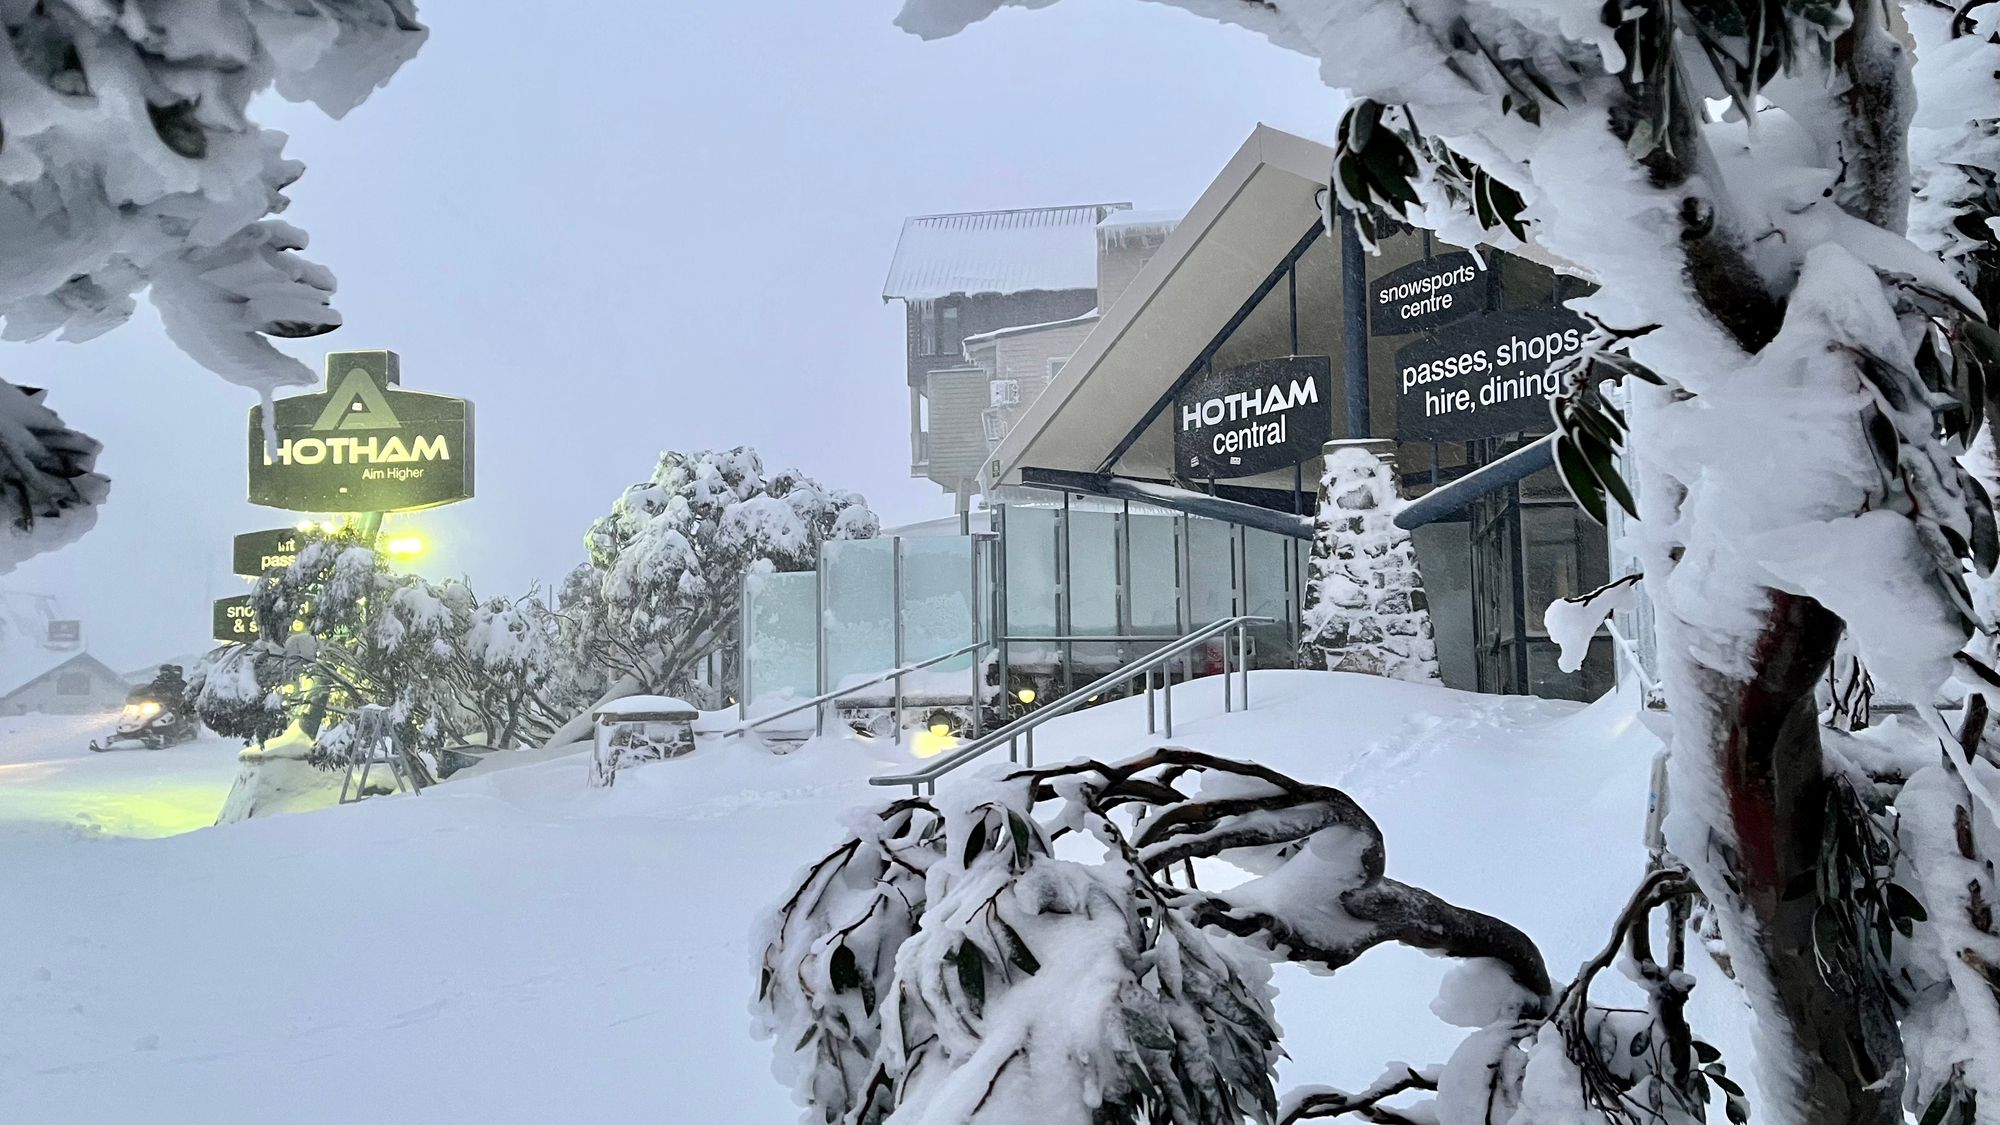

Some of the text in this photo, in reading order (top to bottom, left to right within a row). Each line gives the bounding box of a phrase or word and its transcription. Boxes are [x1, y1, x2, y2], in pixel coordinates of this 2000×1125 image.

[1380, 265, 1475, 304] snowsports
[1401, 293, 1453, 319] centre
[1403, 350, 1493, 394] passes,
[1183, 375, 1319, 431] HOTHAM
[1426, 370, 1560, 417] hire, dining
[263, 434, 450, 465] HOTHAM
[1213, 413, 1286, 455] central
[362, 467, 425, 481] Aim Higher
